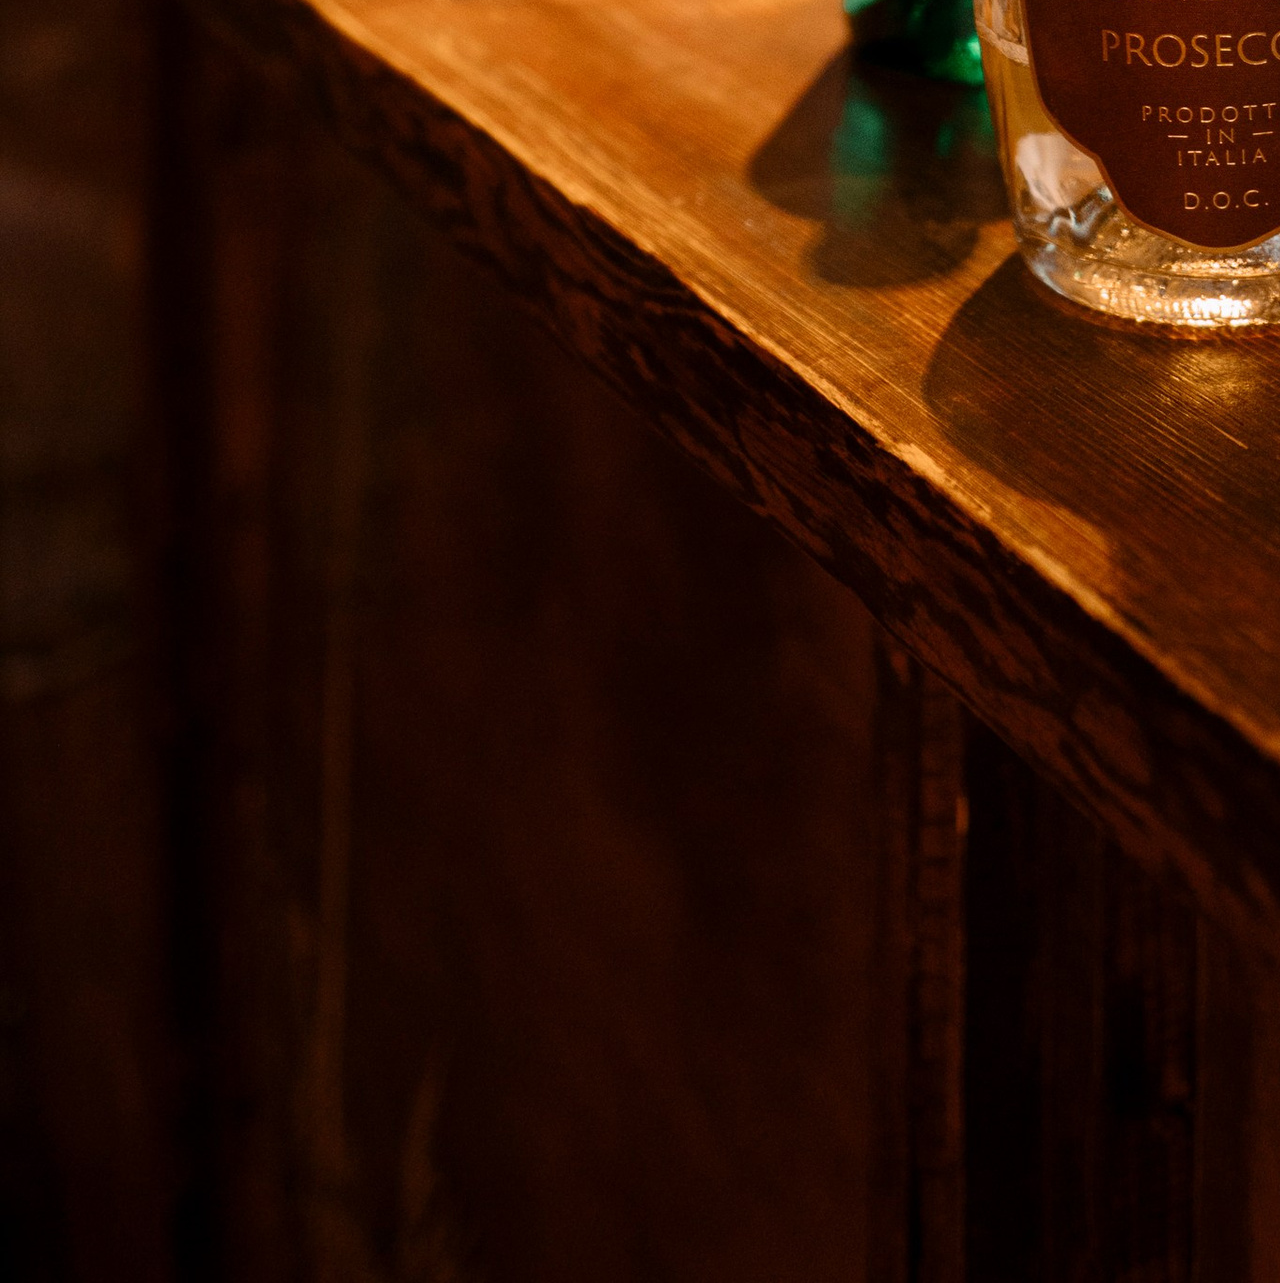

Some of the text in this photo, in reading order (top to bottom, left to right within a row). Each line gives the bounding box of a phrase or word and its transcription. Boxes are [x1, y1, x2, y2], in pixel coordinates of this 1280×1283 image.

[1206, 127, 1235, 145] IN
[1177, 147, 1268, 167] ITALIA
[1183, 188, 1270, 211] D.O.C.
